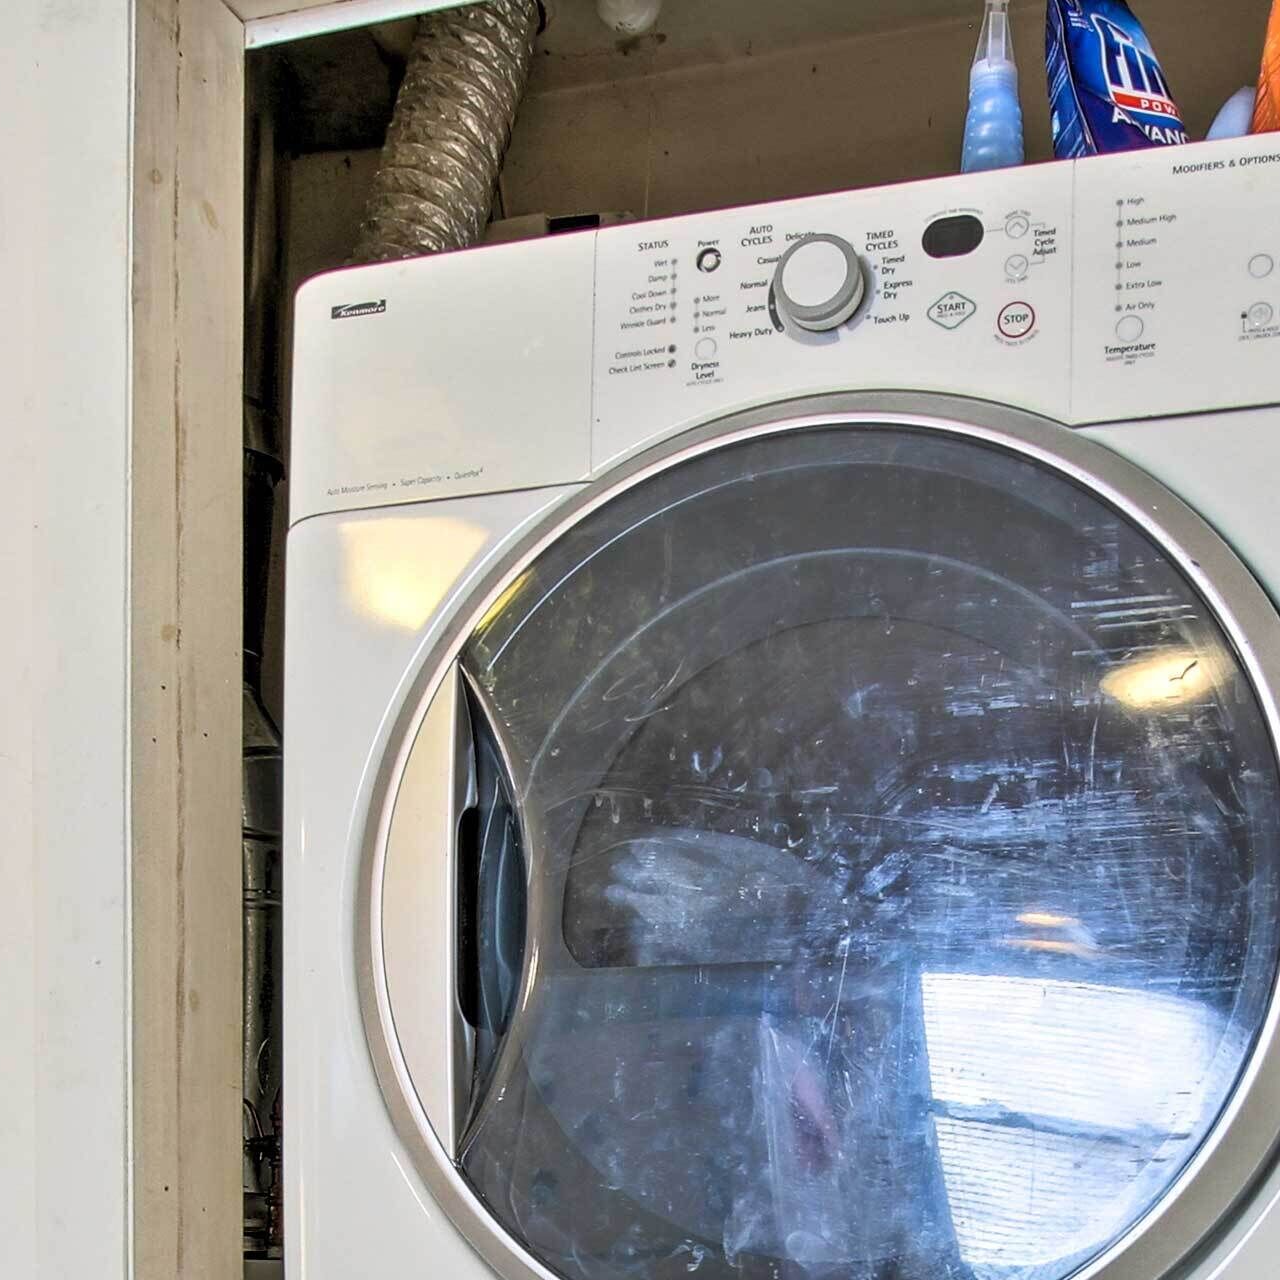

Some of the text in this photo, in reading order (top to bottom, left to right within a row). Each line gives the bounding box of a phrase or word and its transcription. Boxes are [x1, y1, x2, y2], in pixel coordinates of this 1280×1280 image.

[1172, 160, 1225, 175] MODIFIERS
[1229, 159, 1236, 168] &
[1127, 197, 1144, 206] High
[1127, 214, 1176, 226] Medium High
[749, 225, 773, 235] AUTO
[866, 230, 894, 240] TIMED
[1033, 227, 1056, 237] Timed
[638, 240, 669, 251] STATUS
[697, 239, 720, 247] Power
[741, 235, 773, 247] CYCLES
[865, 240, 898, 252] CYCLES
[1034, 237, 1055, 247] Cycle
[1126, 238, 1157, 247] Medium
[1032, 247, 1056, 257] Adjust
[757, 254, 782, 265] Casual
[882, 254, 905, 265] Timed
[1126, 261, 1141, 269] Low
[881, 266, 895, 275] Dry
[740, 279, 768, 290] Normal
[884, 280, 912, 290] Express
[1126, 280, 1162, 290] Extra Low
[883, 291, 897, 300] Dry
[340, 304, 386, 317] Kenmore
[746, 304, 765, 313] Jeans
[937, 302, 966, 314] START
[1138, 302, 1155, 310] Only
[702, 307, 727, 317] Normal
[874, 313, 910, 325] Touch Up
[1004, 313, 1029, 325] STOP
[729, 327, 773, 340] Heavy Duty
[1104, 342, 1156, 356] Temperature
[691, 361, 720, 371] Dryness
[695, 370, 715, 380] Level
